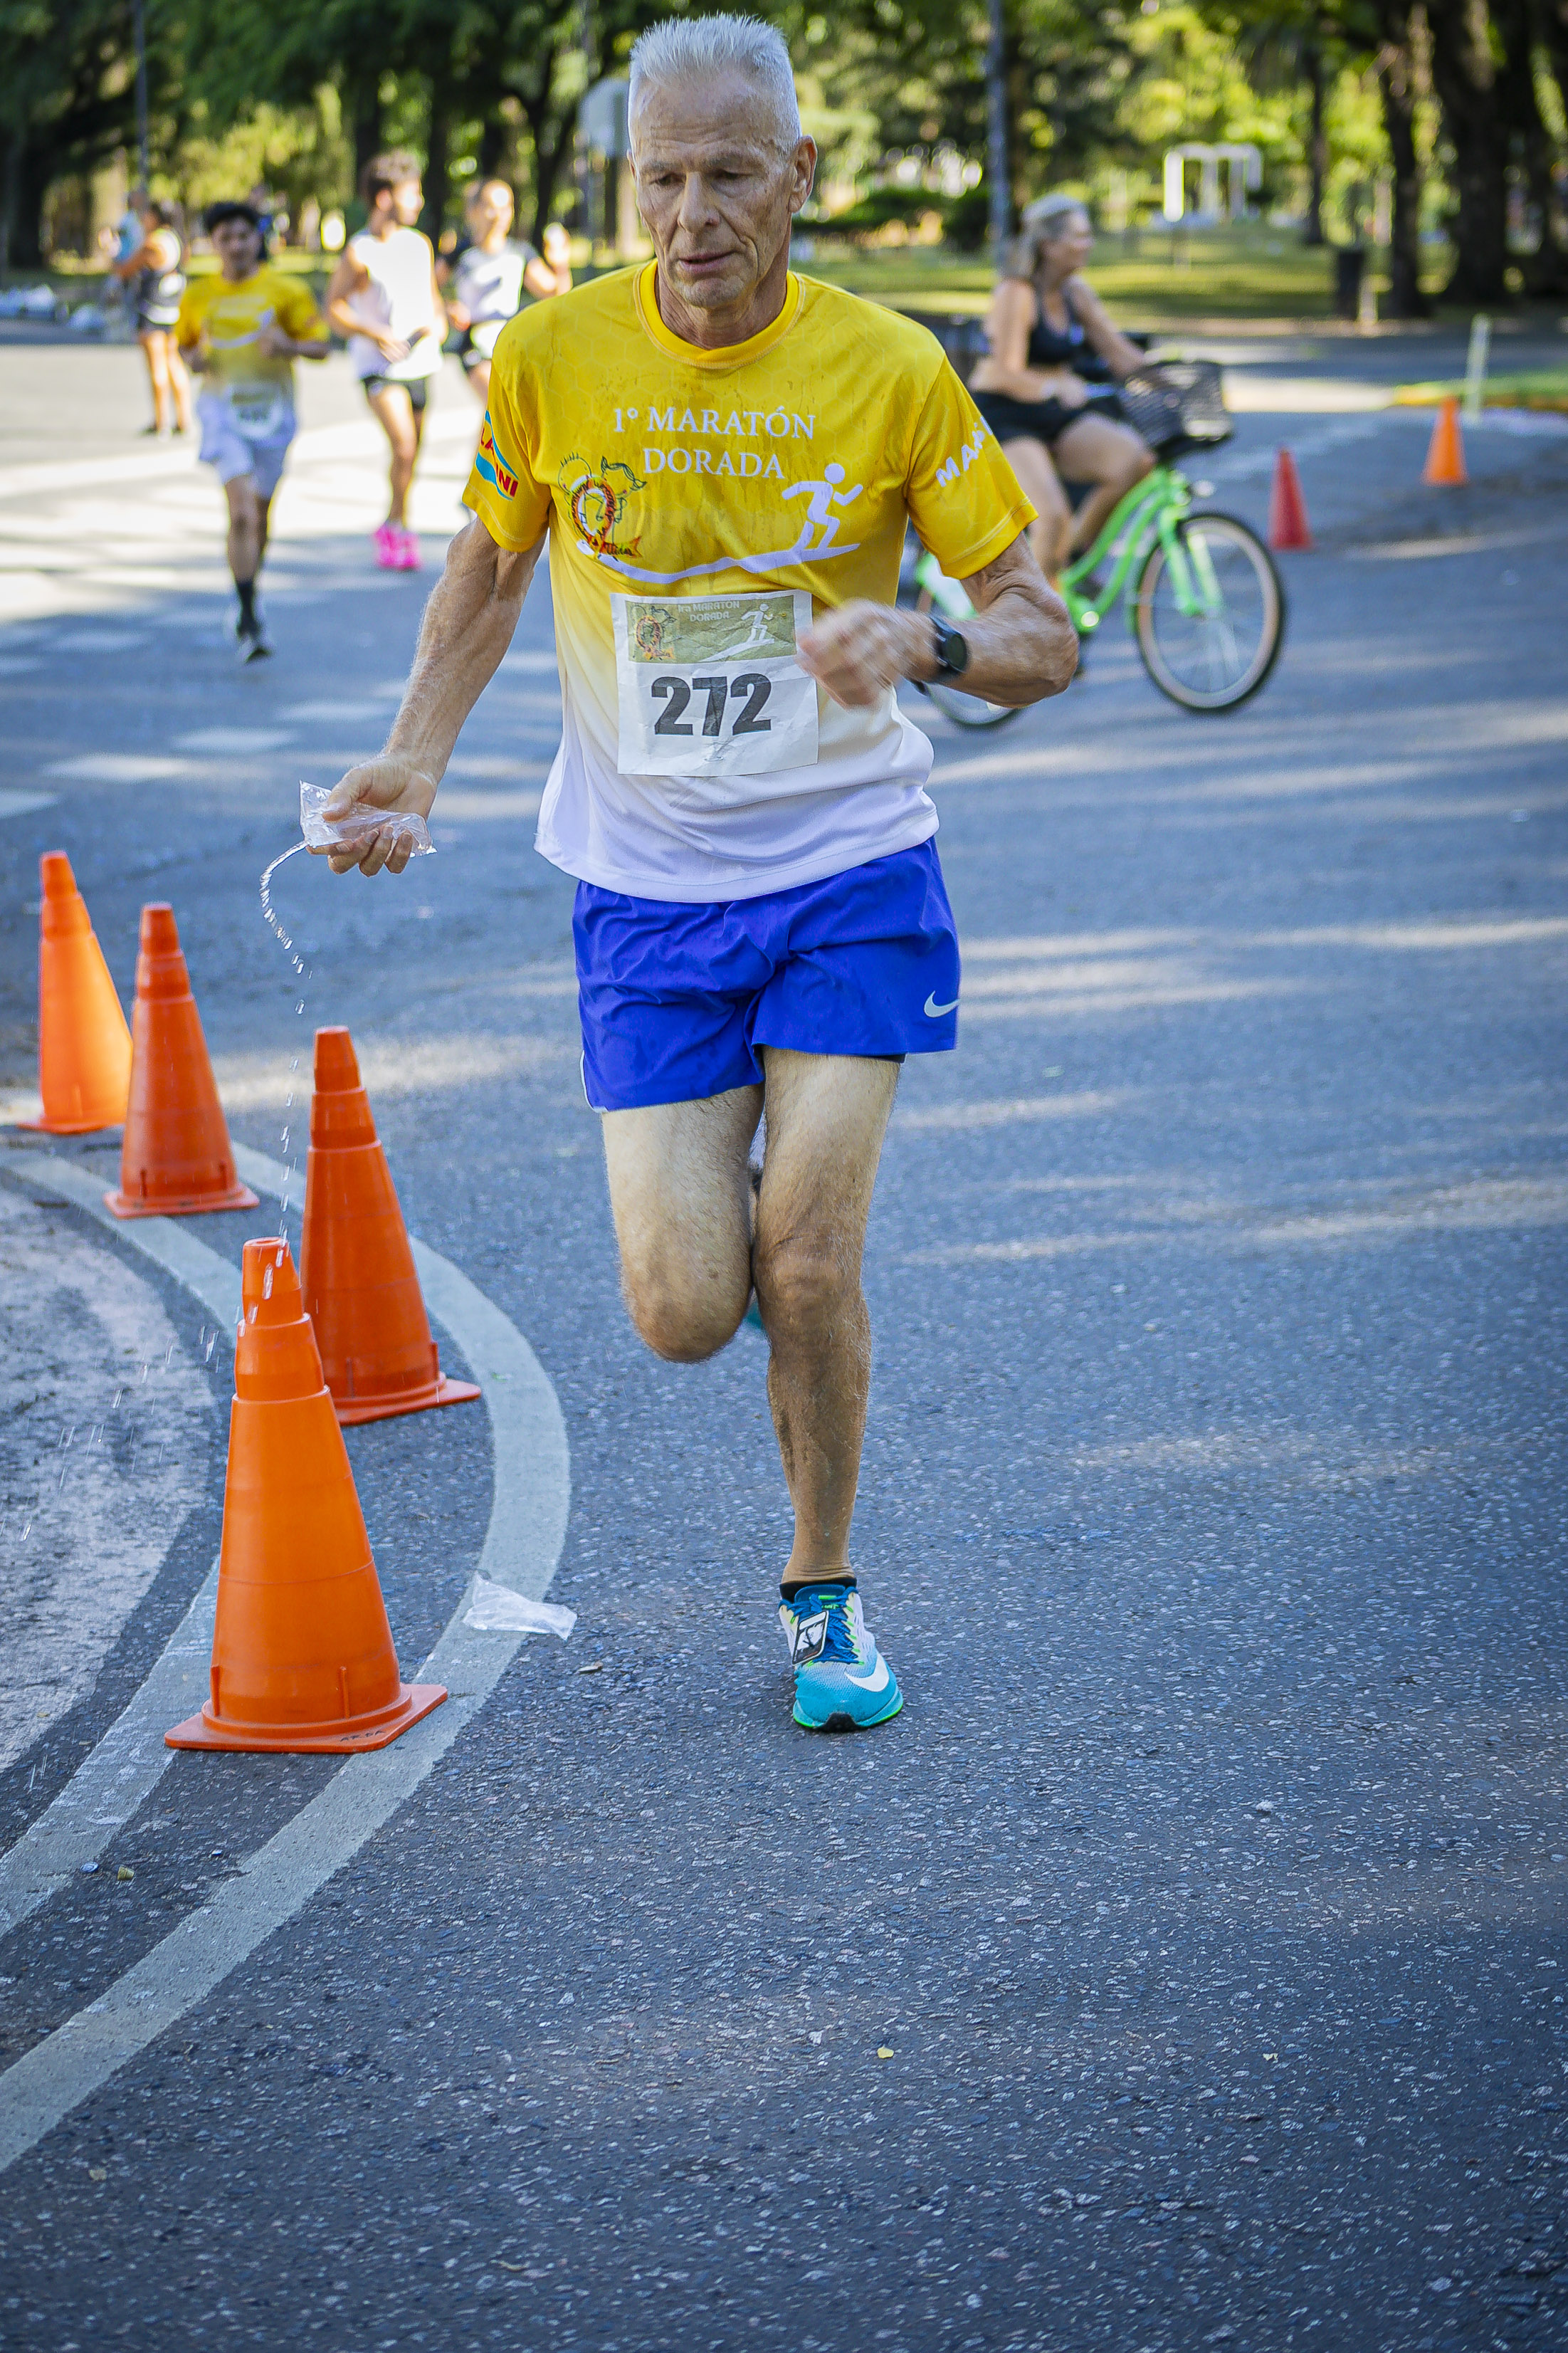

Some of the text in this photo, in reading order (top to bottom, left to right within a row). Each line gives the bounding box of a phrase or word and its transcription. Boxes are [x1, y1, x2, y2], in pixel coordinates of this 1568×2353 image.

[647, 405, 816, 439] MARATÓN
[643, 448, 786, 479] DORADA
[690, 612, 729, 622] DORADA
[651, 673, 772, 737] 272
